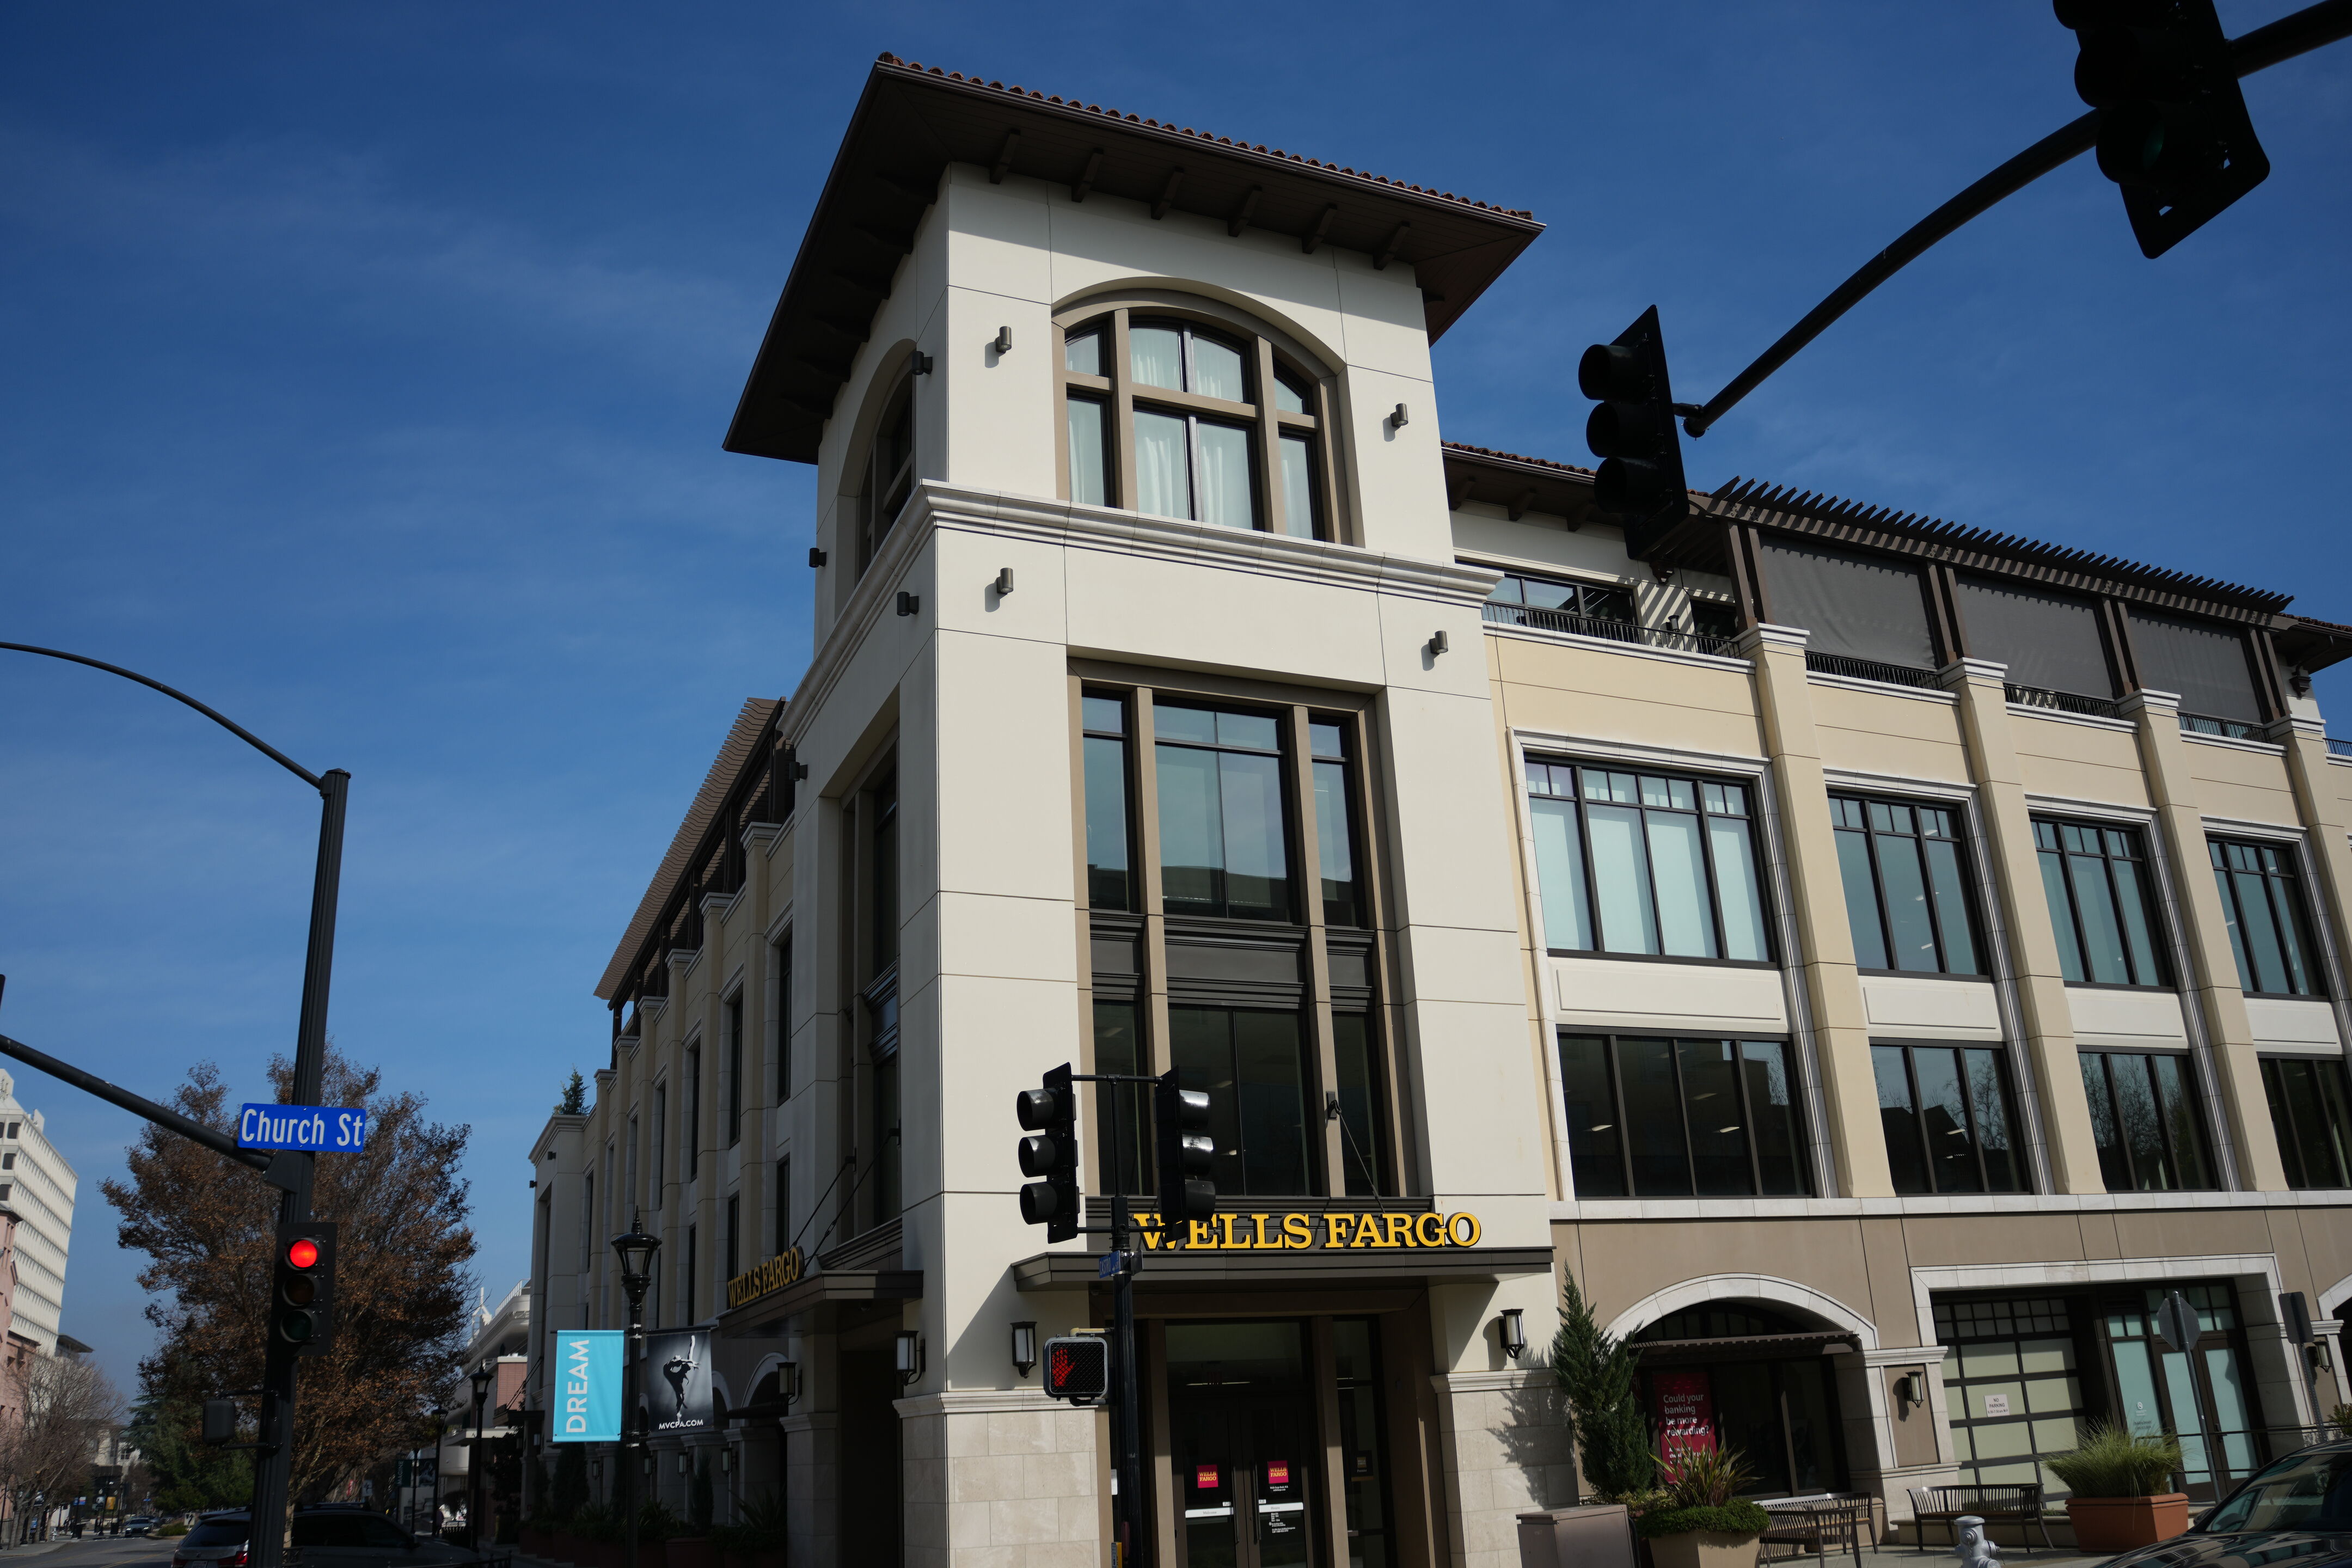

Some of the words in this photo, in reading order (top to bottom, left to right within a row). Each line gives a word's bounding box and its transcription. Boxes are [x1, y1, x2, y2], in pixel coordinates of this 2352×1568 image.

[242, 1108, 325, 1144] Church
[336, 1113, 363, 1146] St
[1133, 1214, 1313, 1250] WELLS
[1323, 1211, 1482, 1248] FARGO
[1100, 1257, 1111, 1276] CASTRO
[727, 1267, 761, 1309] WELLS
[761, 1247, 799, 1295] FARGO
[566, 1339, 589, 1433] DREAM
[1663, 1394, 1685, 1403] Could
[1687, 1394, 1704, 1404] your
[1664, 1404, 1696, 1414] banking
[658, 1419, 703, 1430] MVCPA.COM
[1665, 1416, 1676, 1425] be
[1677, 1417, 1698, 1425] more
[1667, 1425, 1710, 1436] rewarding?
